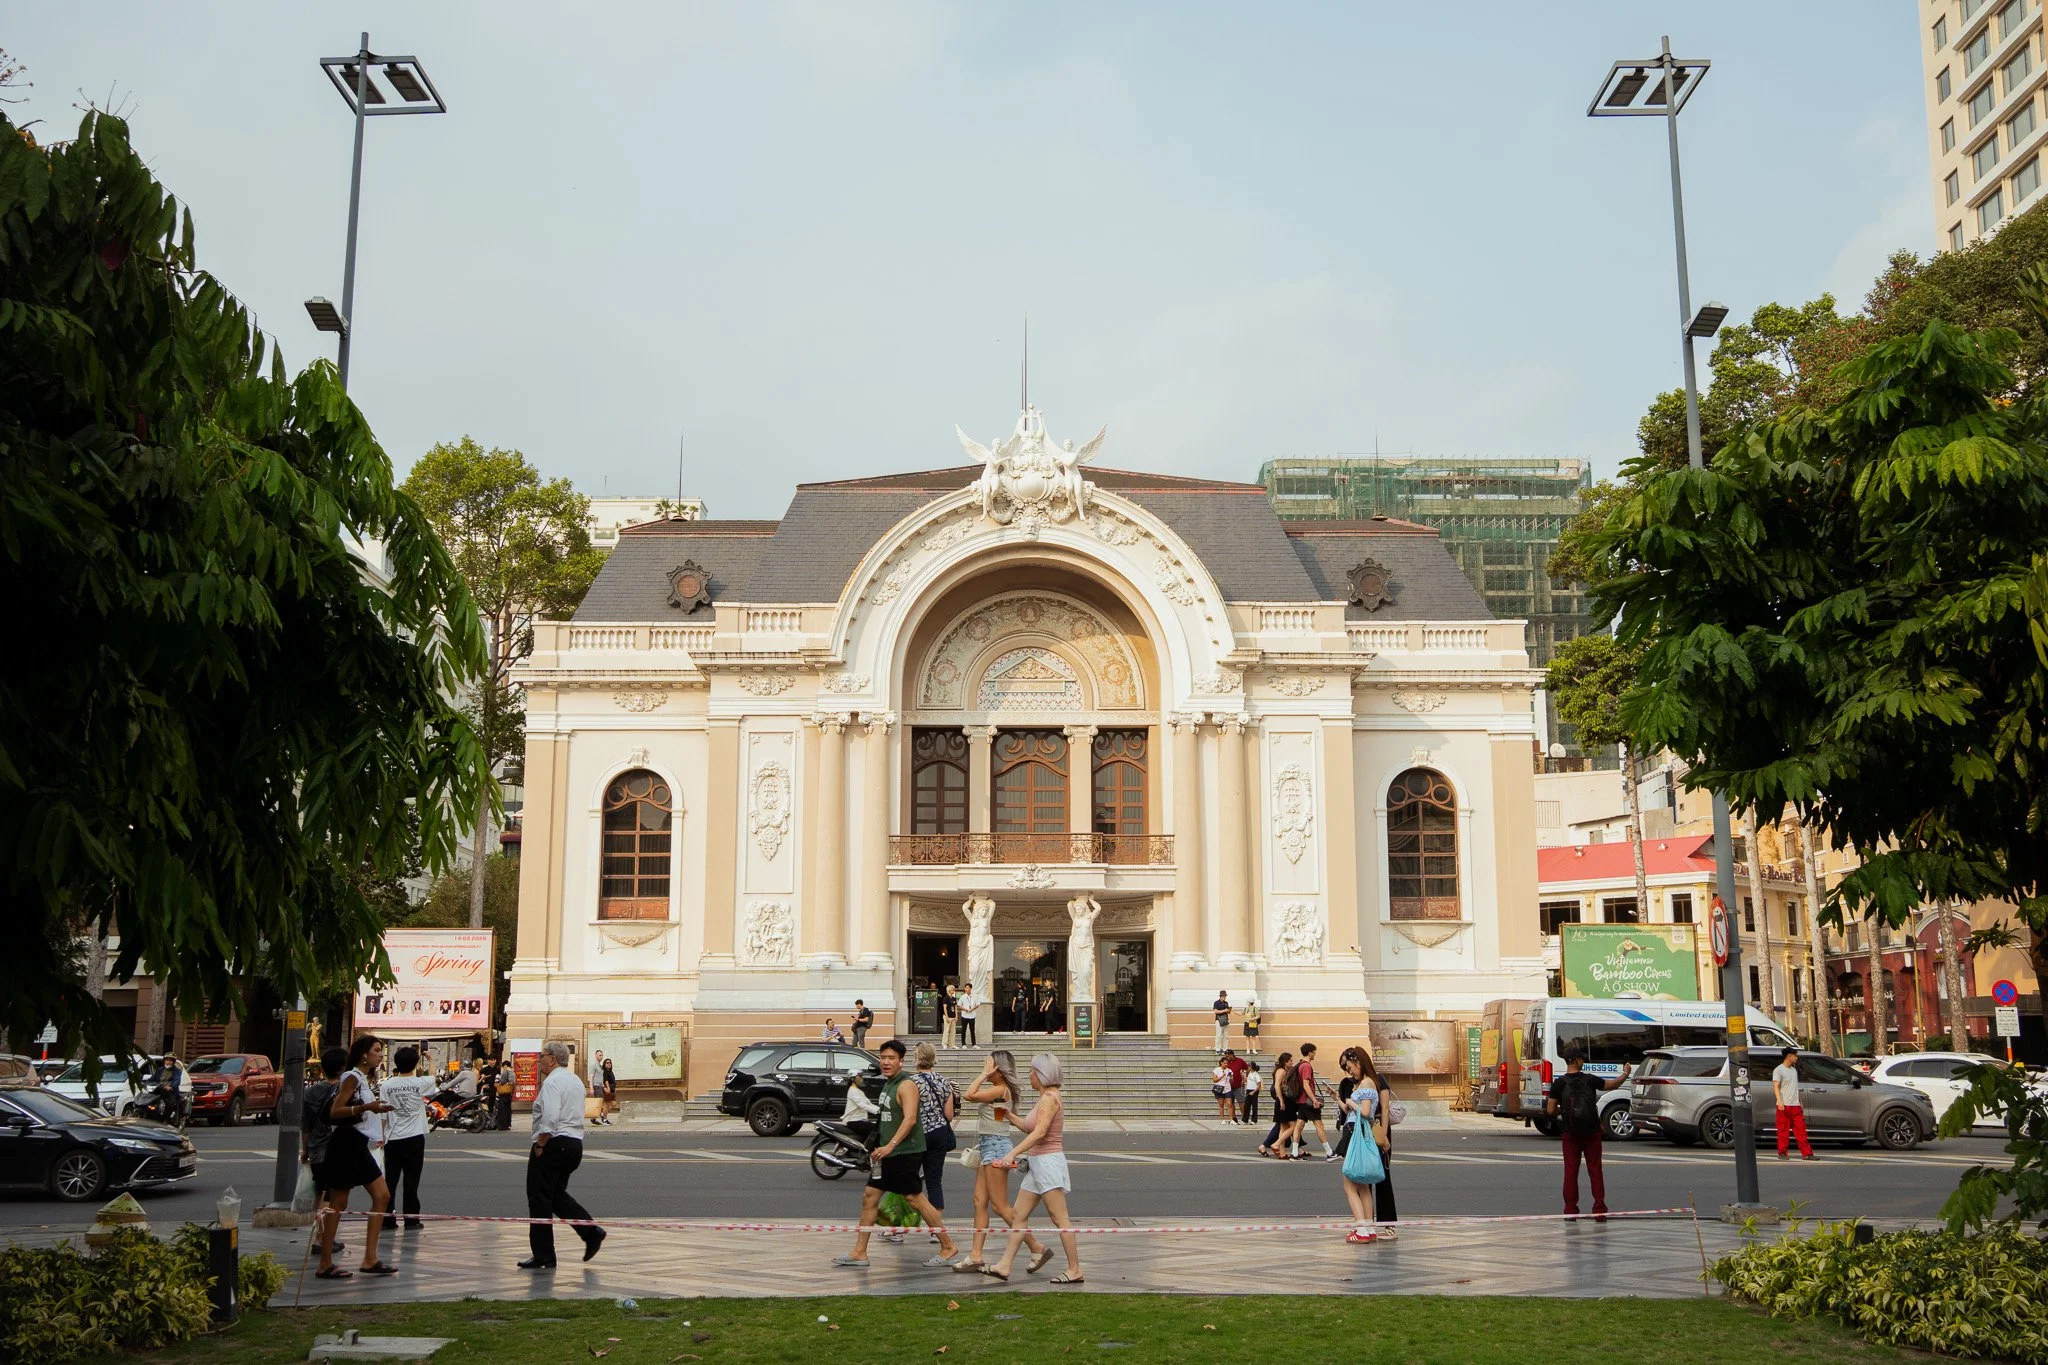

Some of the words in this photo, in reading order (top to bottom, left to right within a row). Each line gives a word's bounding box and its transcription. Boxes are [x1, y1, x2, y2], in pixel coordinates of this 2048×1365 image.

[413, 951, 485, 977] Spring
[1605, 953, 1654, 966] Vietnamese
[1589, 963, 1643, 980] Bamboo
[1644, 966, 1672, 979] Circus
[1624, 982, 1660, 992] SHOW
